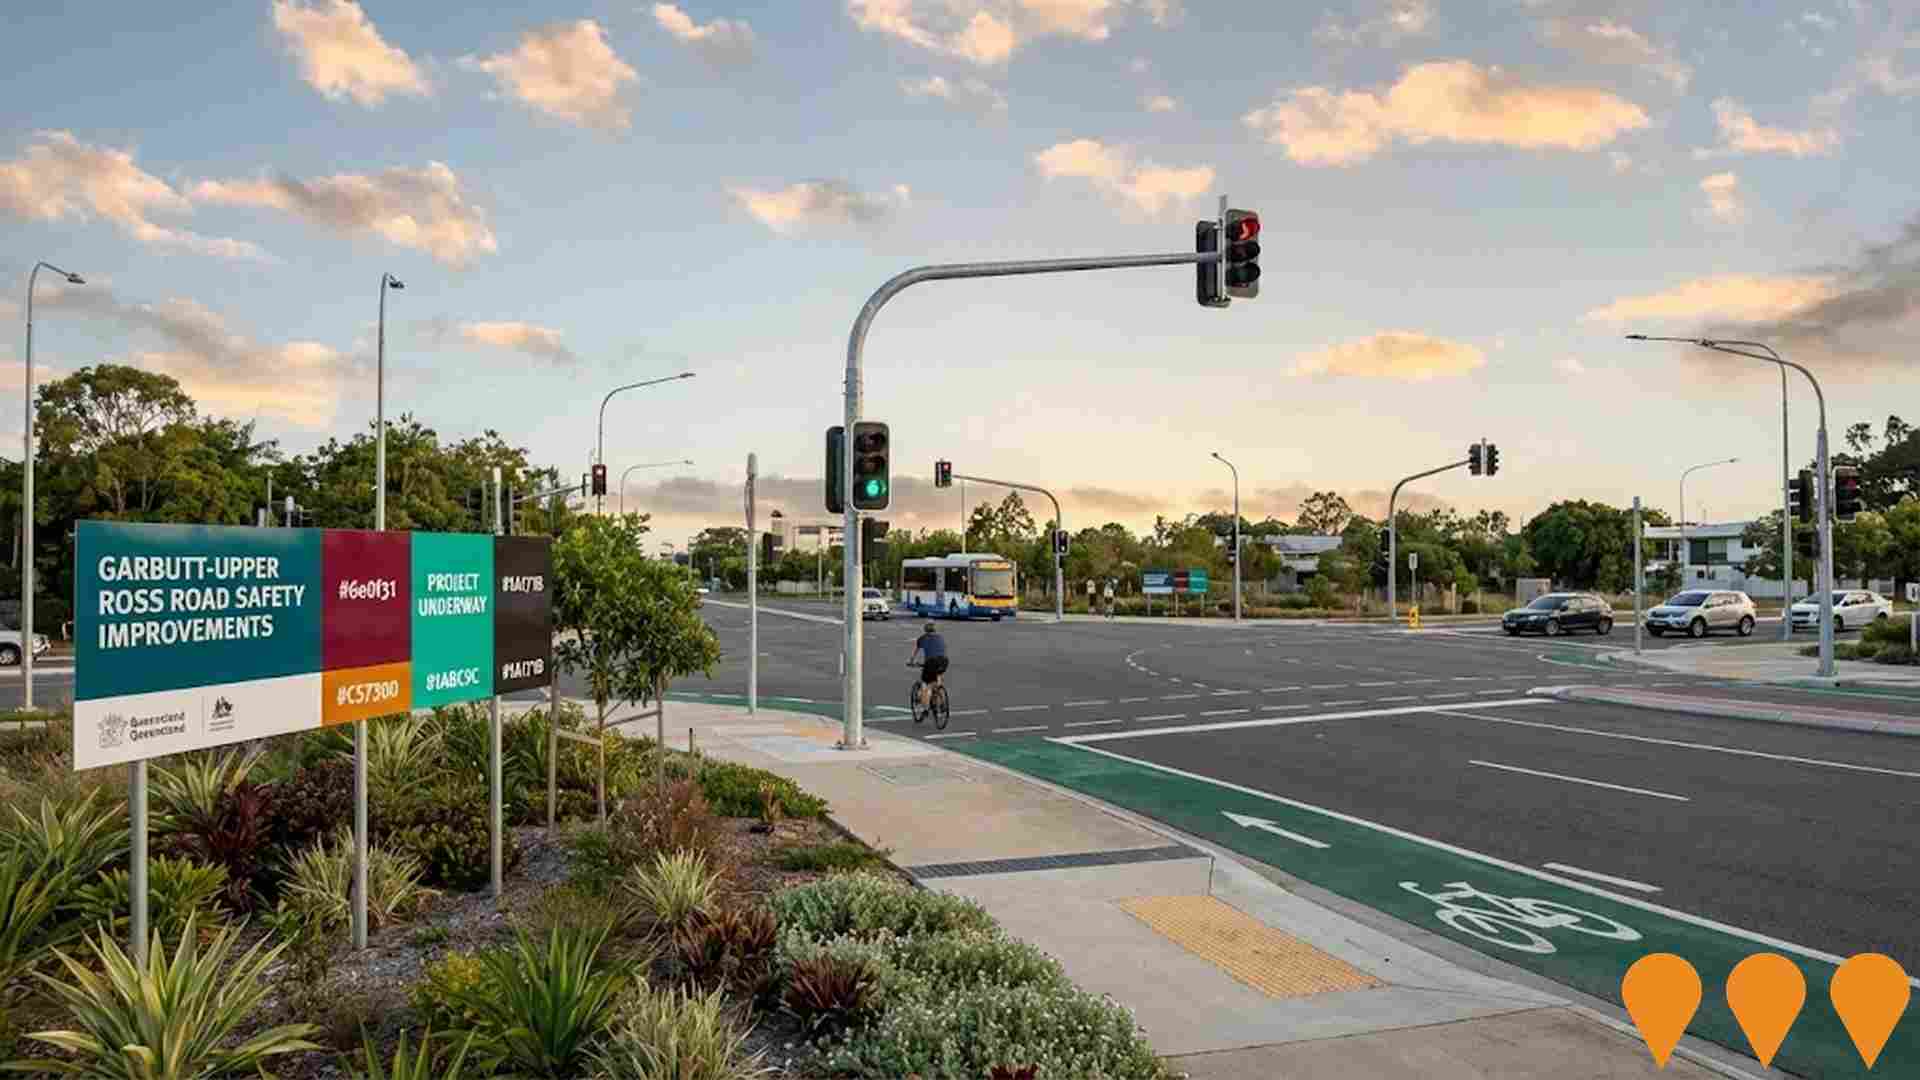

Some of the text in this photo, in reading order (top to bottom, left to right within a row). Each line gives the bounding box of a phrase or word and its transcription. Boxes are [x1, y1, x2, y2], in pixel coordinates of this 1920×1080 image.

[99, 556, 280, 582] GARBUTT-UPPER
[99, 584, 305, 616] ROSS ROAD SAFETY
[418, 595, 487, 617] UNDERWAY
[98, 614, 274, 649] IMPROVEMENTS
